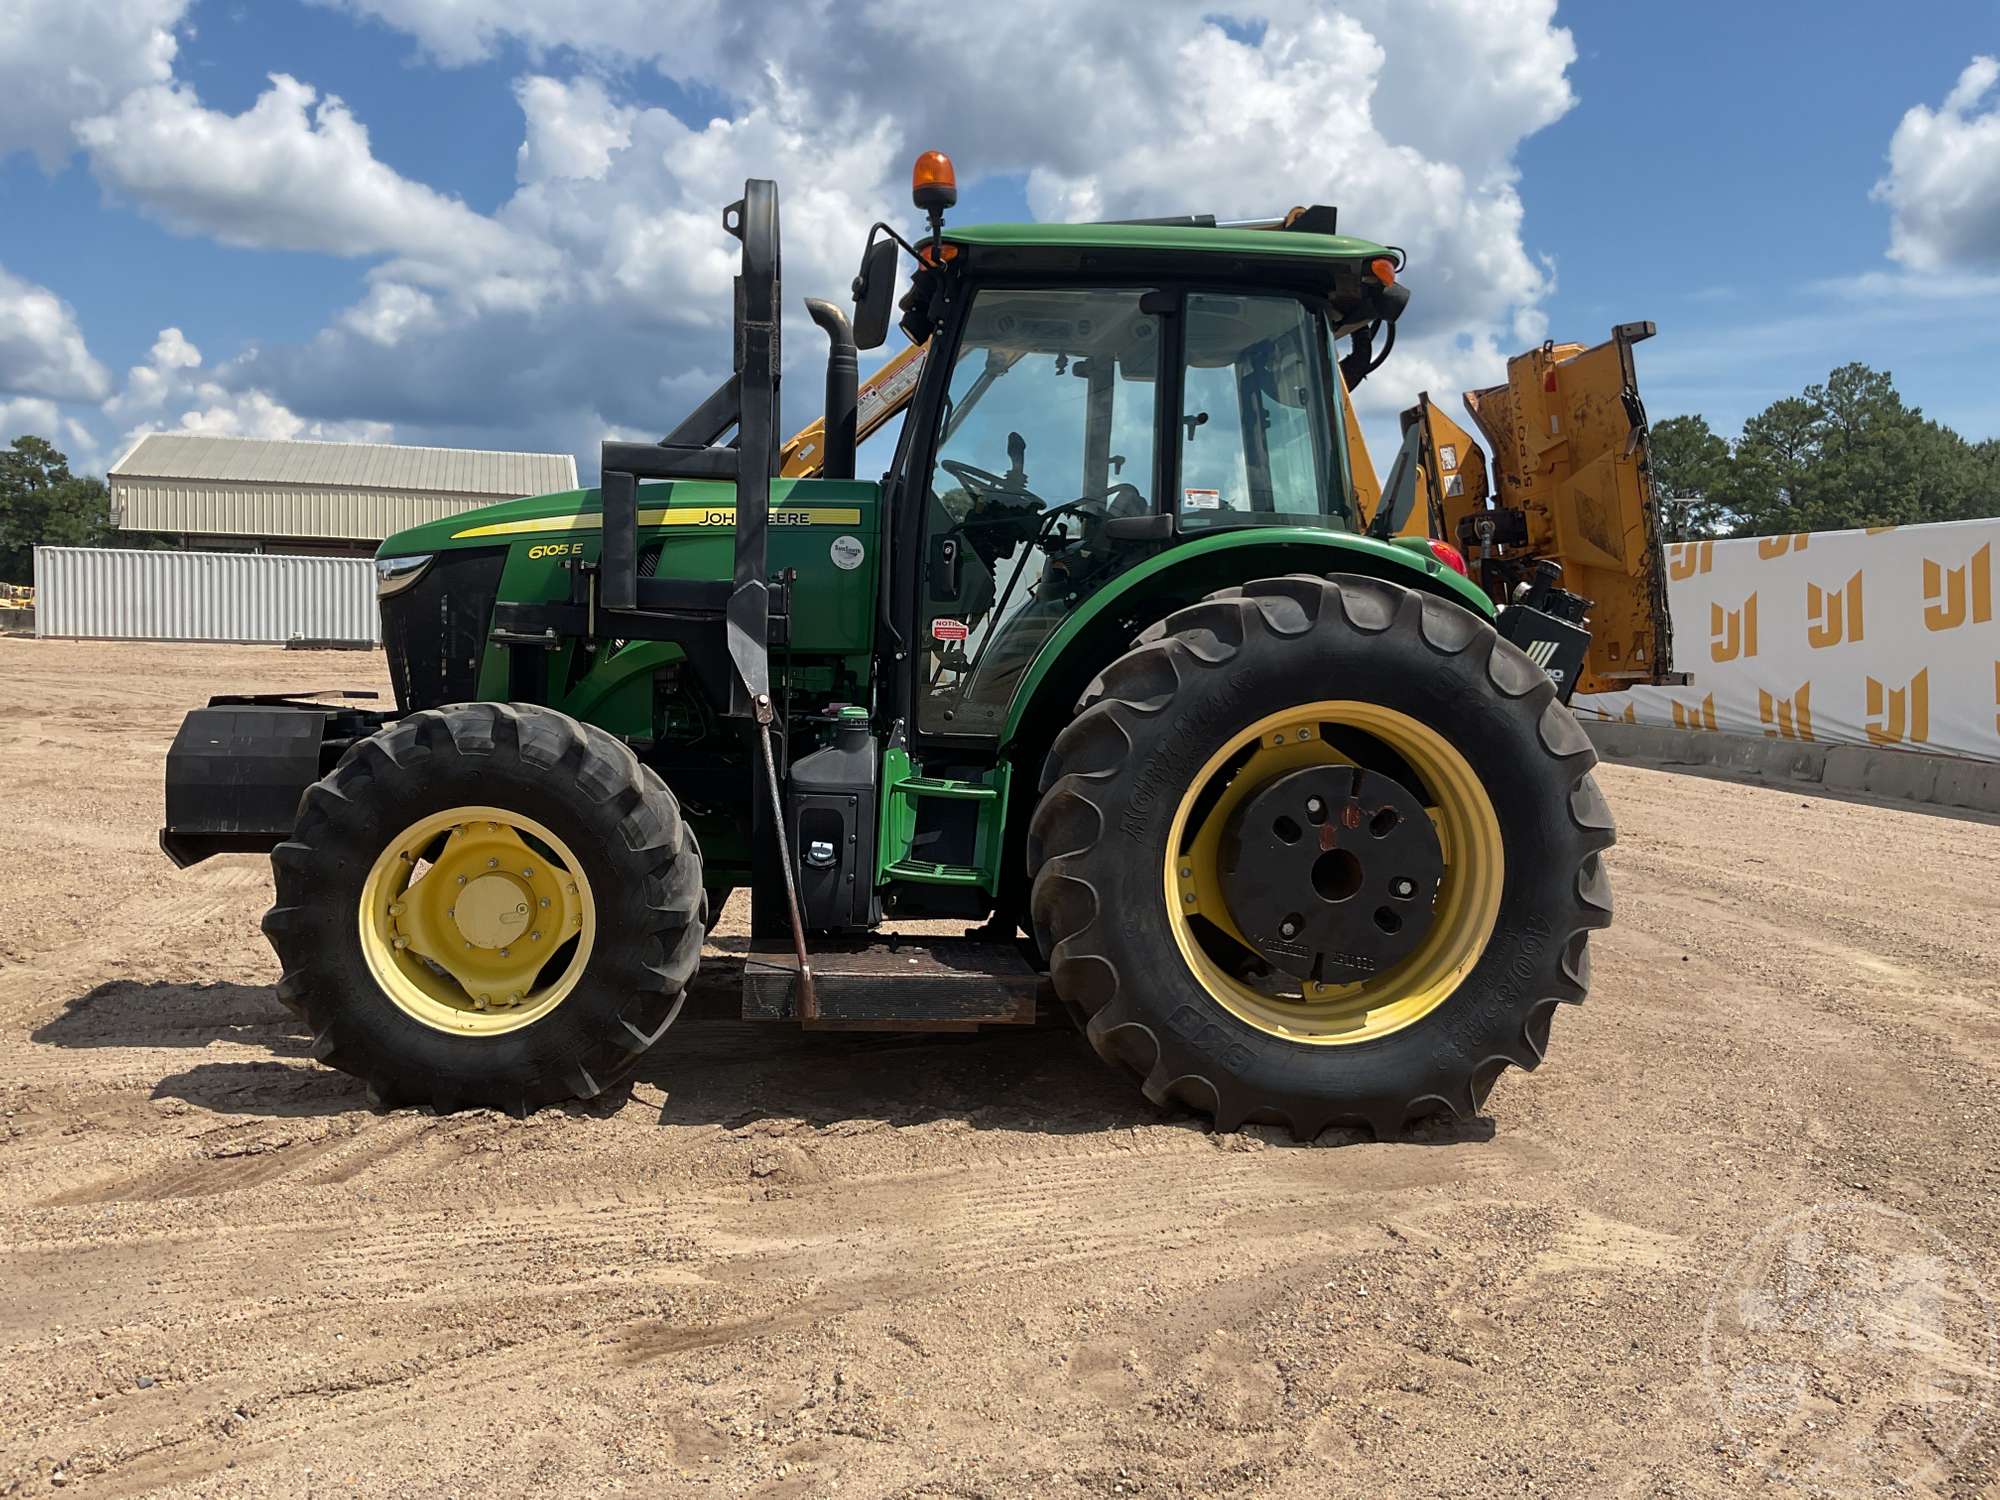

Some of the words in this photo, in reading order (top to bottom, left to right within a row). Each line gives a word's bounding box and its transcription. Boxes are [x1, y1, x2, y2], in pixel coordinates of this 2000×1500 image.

[698, 510, 736, 525] JOH
[767, 512, 811, 525] EERE
[528, 543, 569, 559] 6105
[571, 542, 584, 554] E
